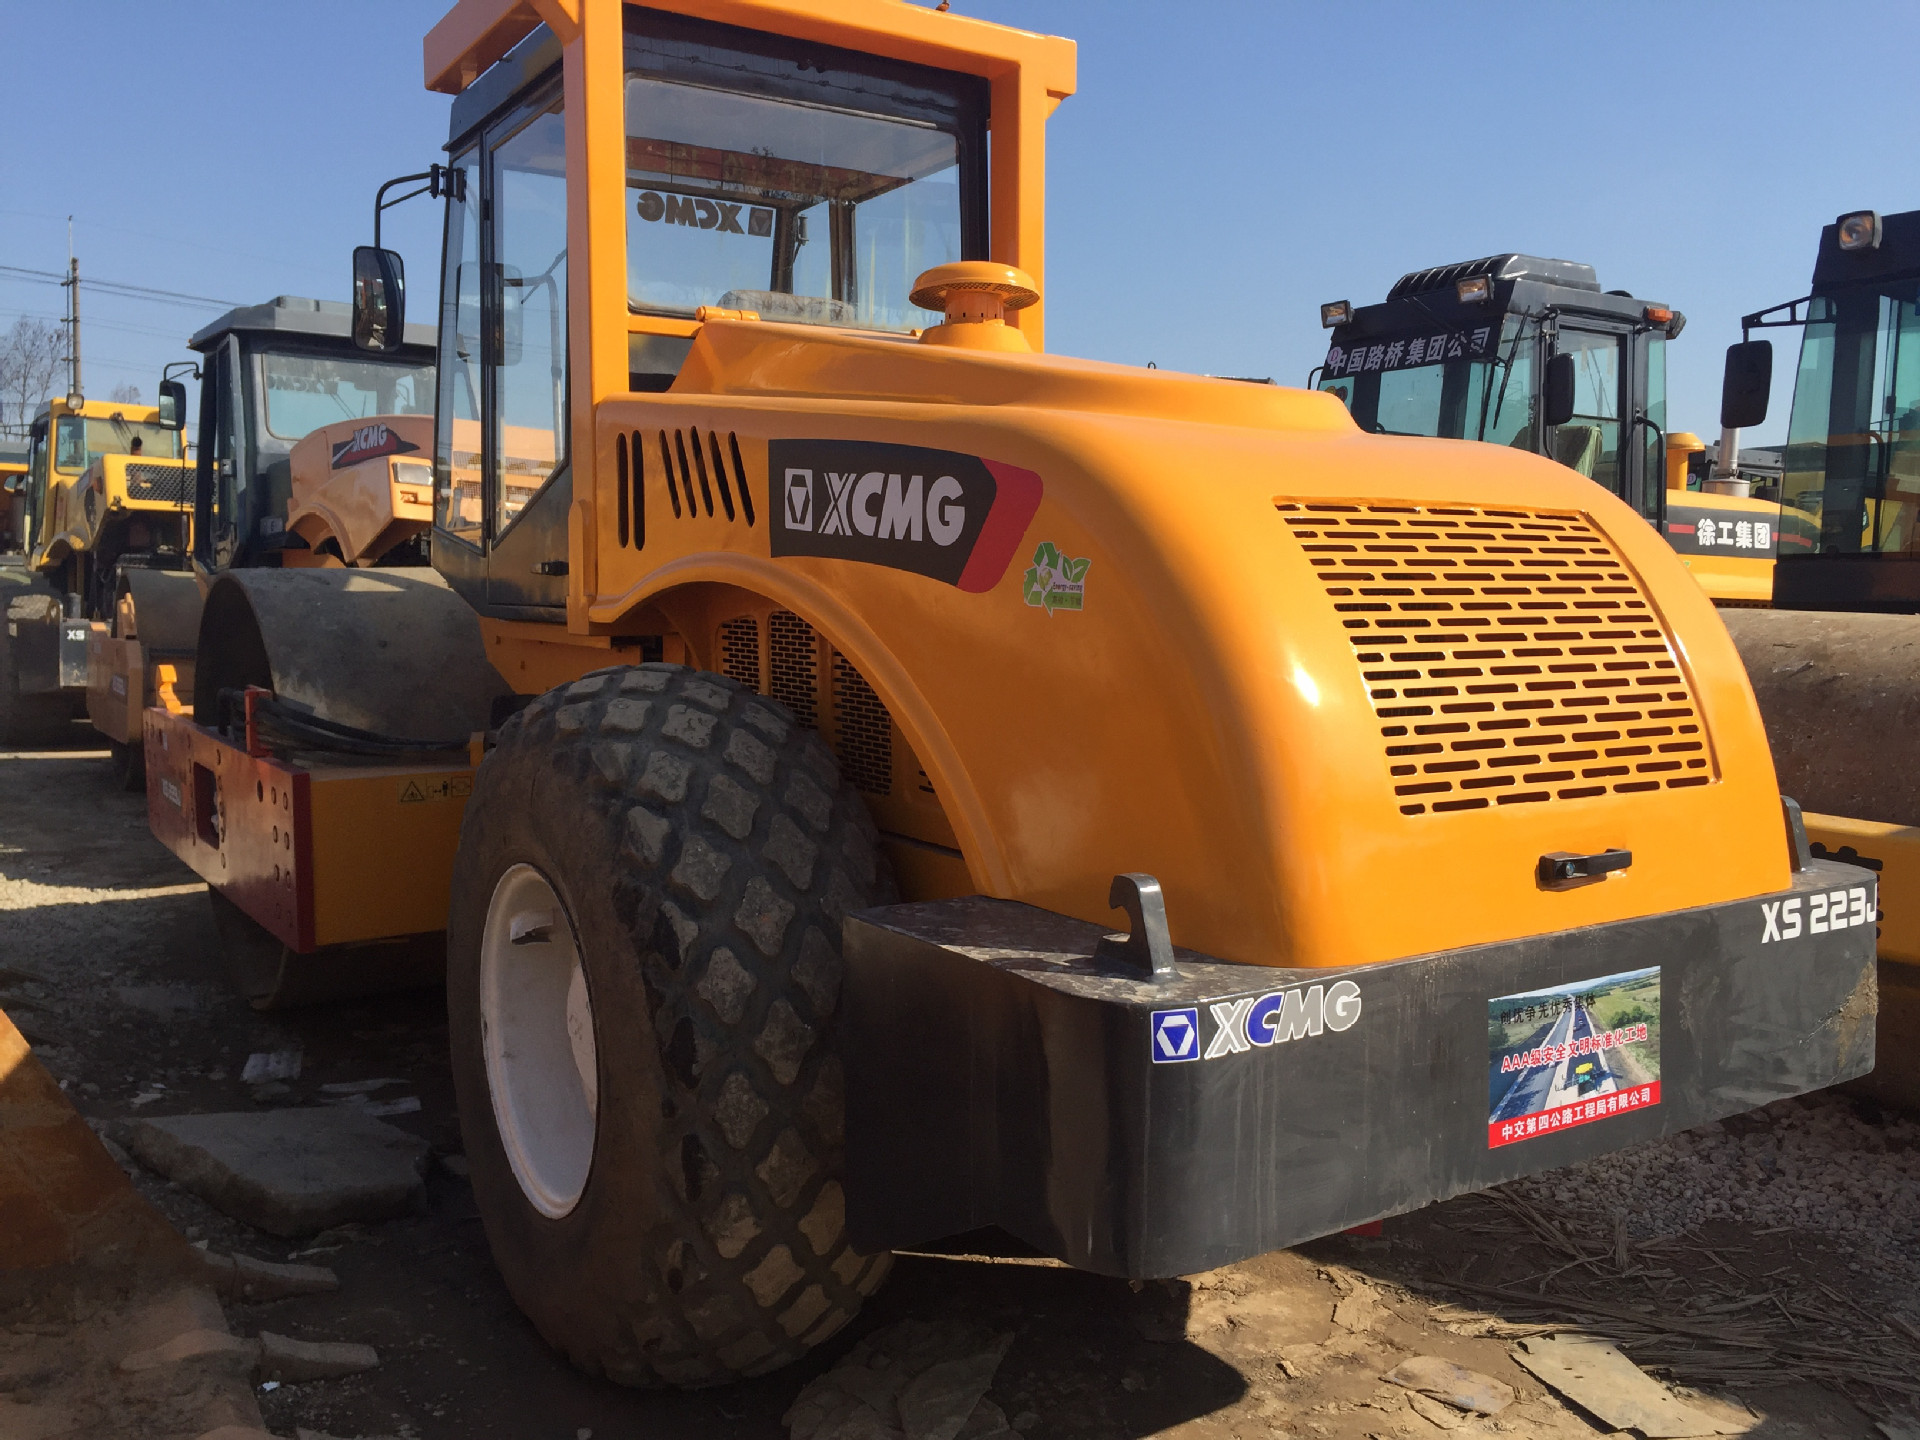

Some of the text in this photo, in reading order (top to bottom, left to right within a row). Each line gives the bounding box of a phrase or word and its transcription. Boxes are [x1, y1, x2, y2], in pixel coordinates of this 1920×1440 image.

[1330, 326, 1491, 376] 中国路桥集团公司
[352, 423, 388, 453] XCMG
[817, 471, 966, 547] XCMG
[1697, 518, 1771, 549] 徐工集团
[66, 629, 85, 641] XS
[1761, 897, 1802, 944] XS
[1203, 980, 1362, 1061] XCMG
[1501, 1022, 1648, 1074] AAA级安全文明标准化工地
[1501, 1087, 1651, 1141] 中交第四公路工程局有限公司
